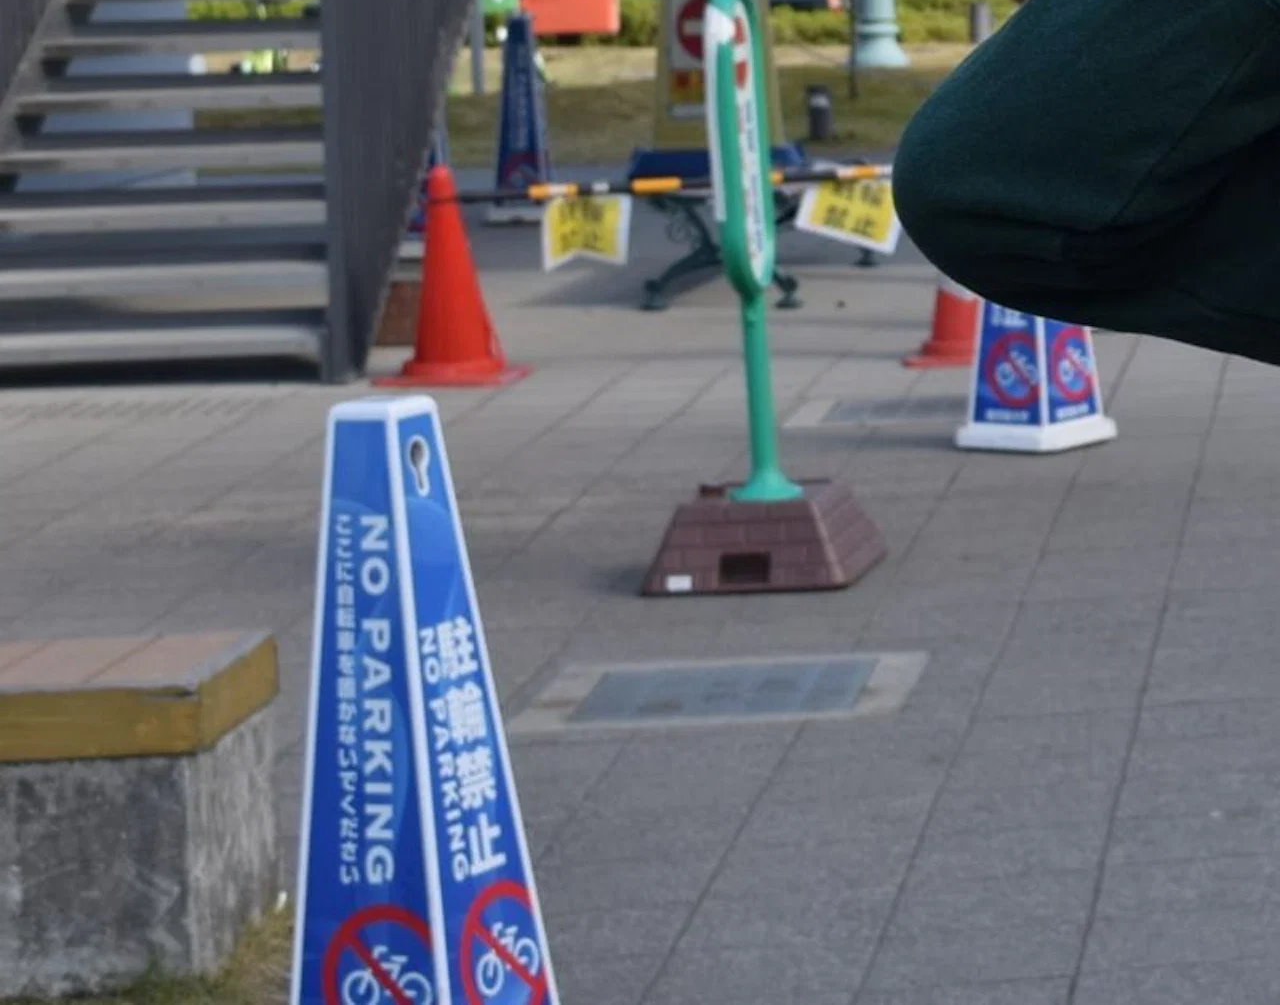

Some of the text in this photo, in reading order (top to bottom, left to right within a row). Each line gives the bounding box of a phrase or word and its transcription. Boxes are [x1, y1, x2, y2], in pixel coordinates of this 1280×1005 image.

[360, 515, 394, 884] NO PARKING
[418, 627, 471, 883] NO PARKING
